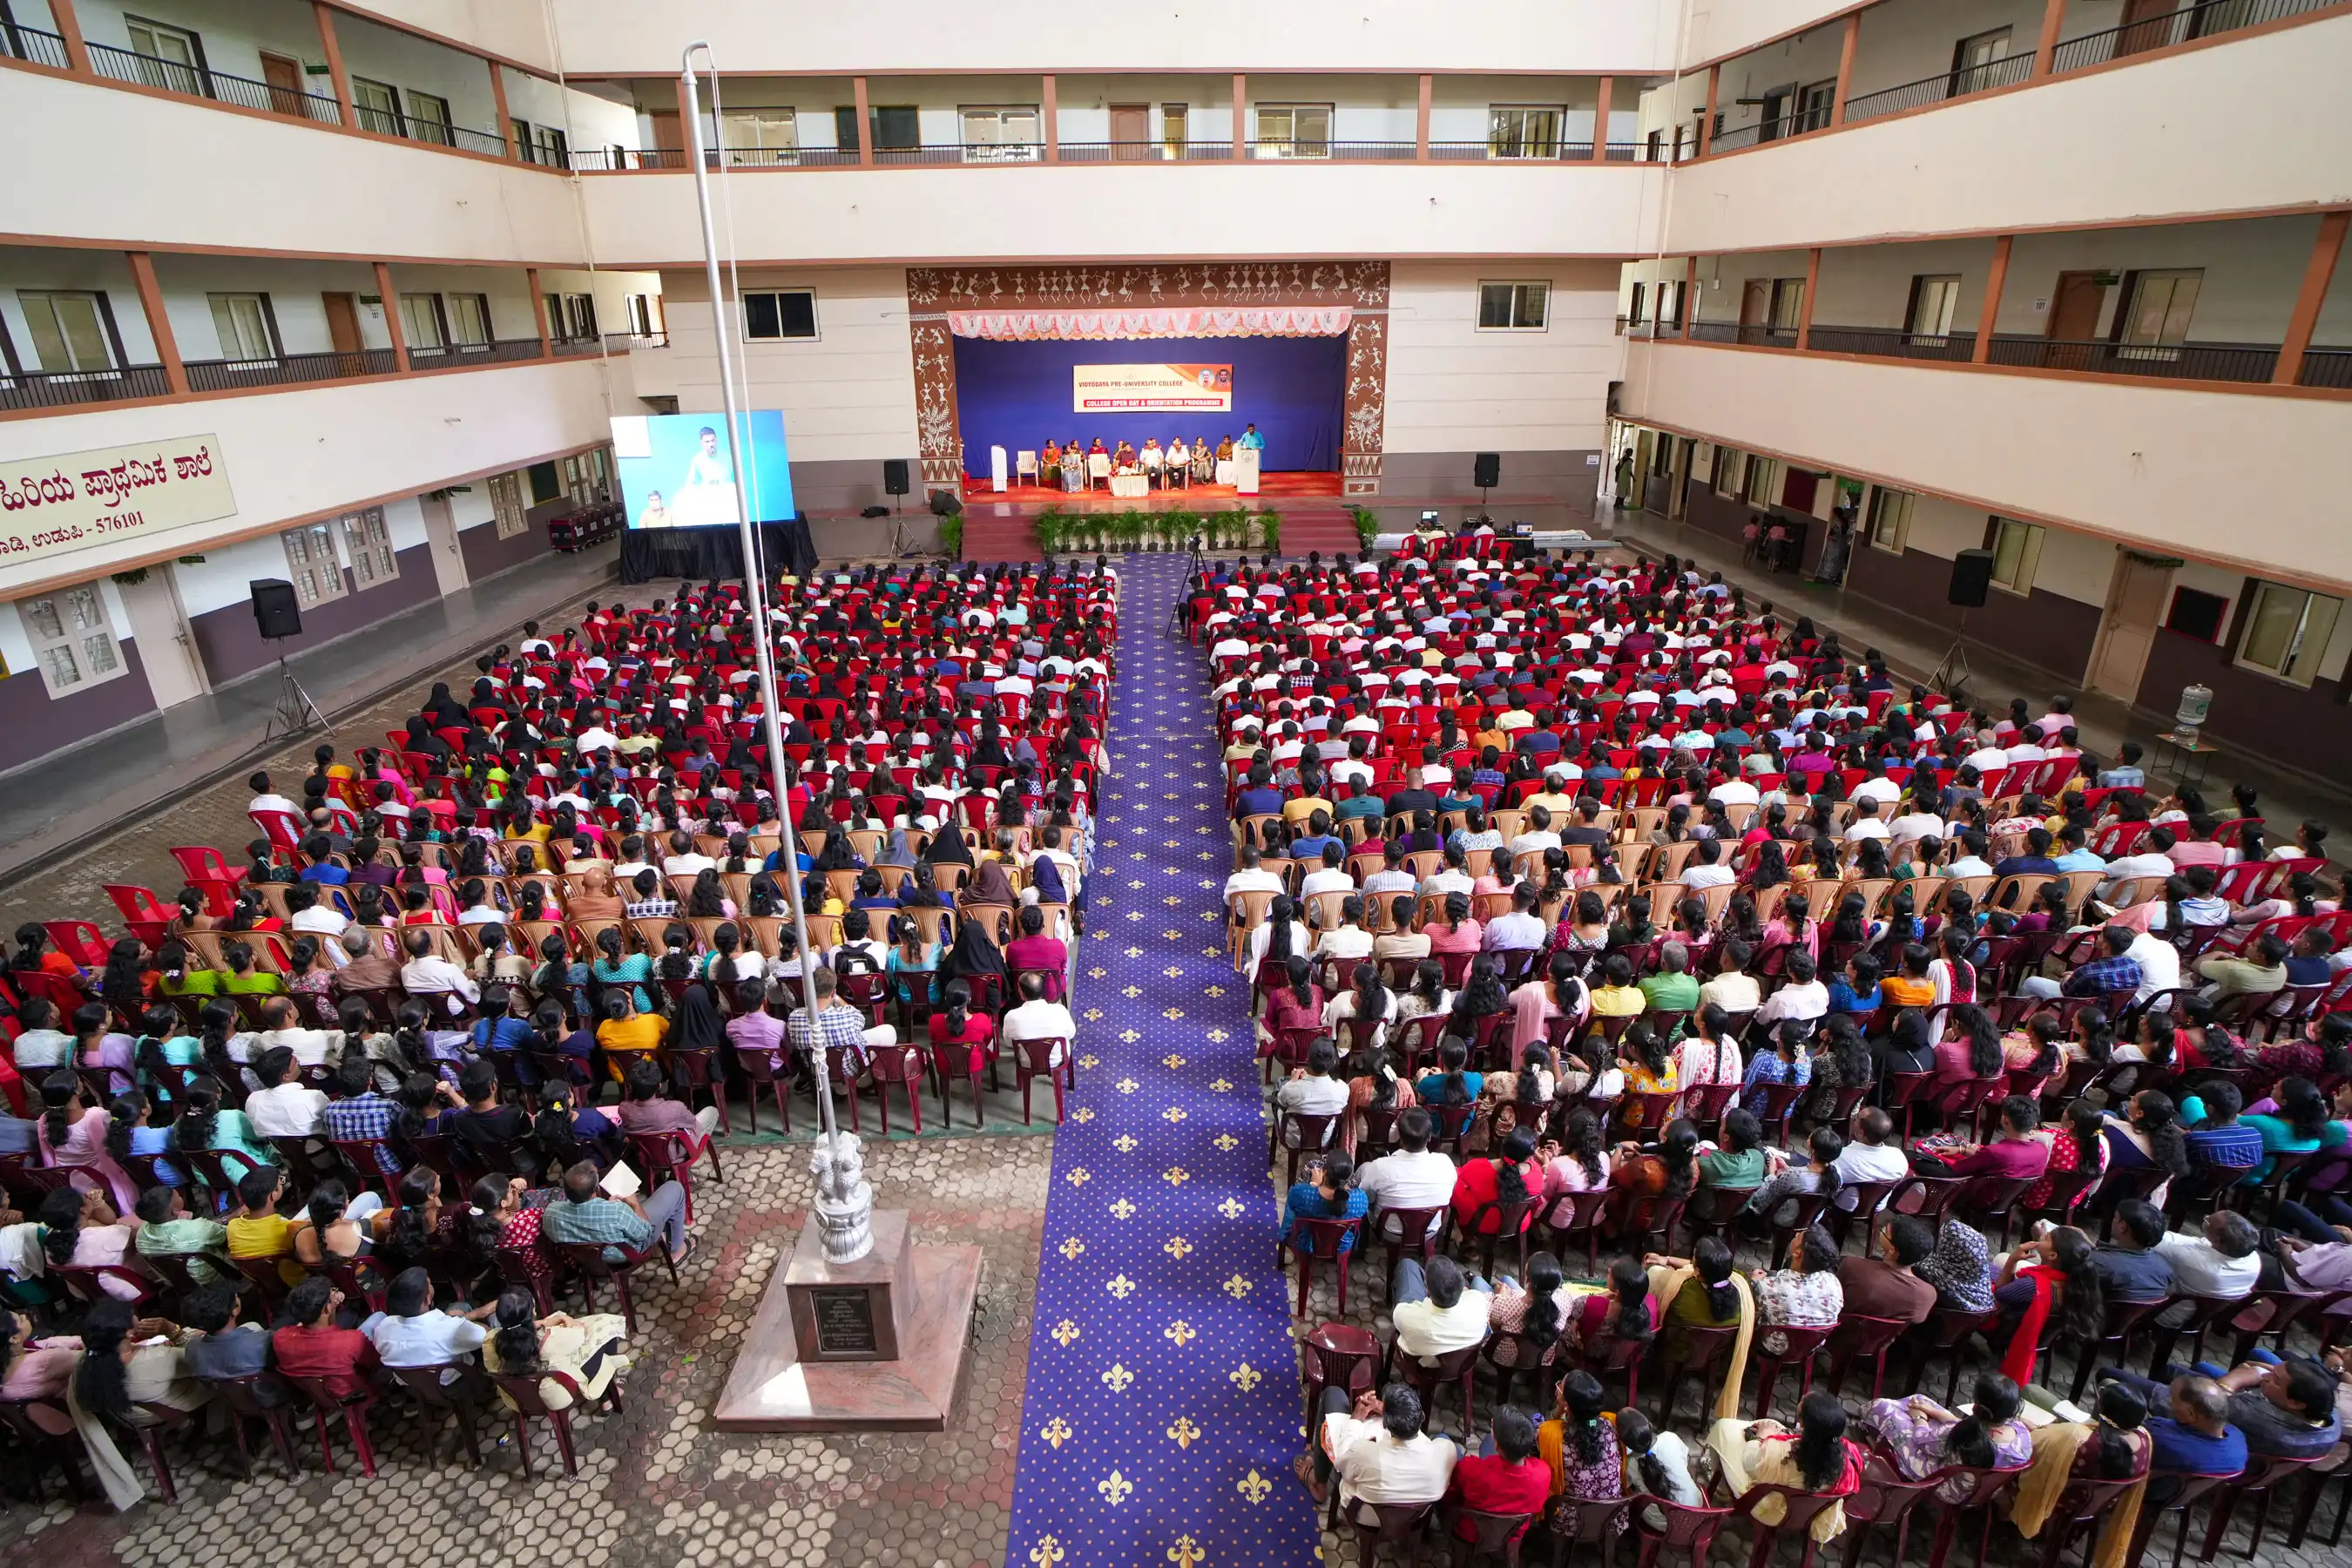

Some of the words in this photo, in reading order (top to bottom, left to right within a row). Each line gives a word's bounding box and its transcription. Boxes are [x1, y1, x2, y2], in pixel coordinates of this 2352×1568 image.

[0, 469, 75, 511] ಹಿರಿಯ
[81, 453, 167, 507] ಪ್ರಾಥಮಿಕ
[173, 445, 213, 480] ಶಾಲೆ
[32, 525, 84, 547] ಉಡುಪಿ
[96, 510, 145, 534] 576101
